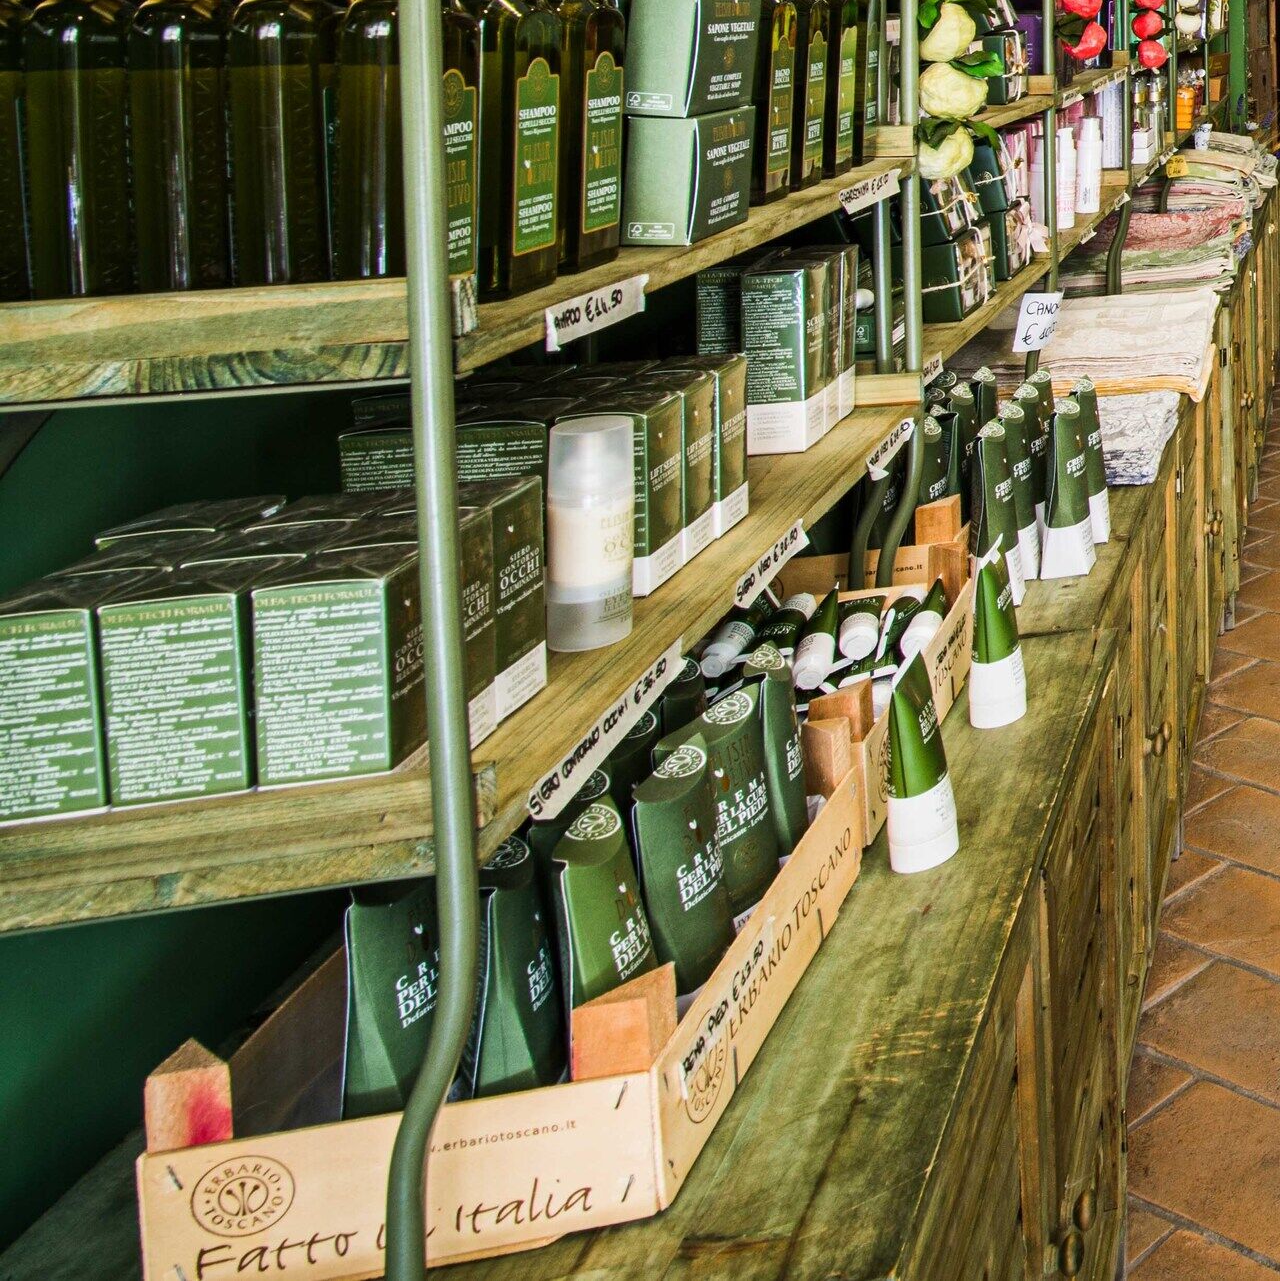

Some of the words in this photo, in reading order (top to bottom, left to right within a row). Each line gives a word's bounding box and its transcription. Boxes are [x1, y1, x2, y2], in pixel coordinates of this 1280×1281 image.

[707, 22, 729, 34] SAPONE
[730, 21, 755, 32] VEGETALE
[519, 105, 556, 120] SHAMPOO
[588, 95, 620, 108] SHAMPOO
[707, 147, 727, 160] SAPONE
[728, 139, 750, 152] VEGETALE
[588, 185, 616, 199] SHAMPOO
[519, 202, 552, 218] SHAMPOO
[554, 306, 581, 331] AMPOO
[509, 544, 531, 562] SIERO
[499, 558, 541, 589] OCCHI
[529, 772, 560, 815] SIERO
[718, 771, 765, 814] REMA
[739, 791, 768, 825] PIEDE
[679, 867, 703, 891] PER
[680, 875, 710, 903] DEL
[793, 826, 852, 931] TOSCANO
[612, 930, 636, 958] PER
[616, 943, 645, 972] DEL
[397, 973, 430, 1005] PER
[399, 984, 437, 1019] DEL
[427, 1118, 577, 1154] .erbariotoscano.it
[204, 1162, 281, 1201] ERBARIO
[204, 1193, 287, 1231] TOSCANO
[196, 1229, 350, 1281] Fatto
[455, 1177, 593, 1236] Italia
